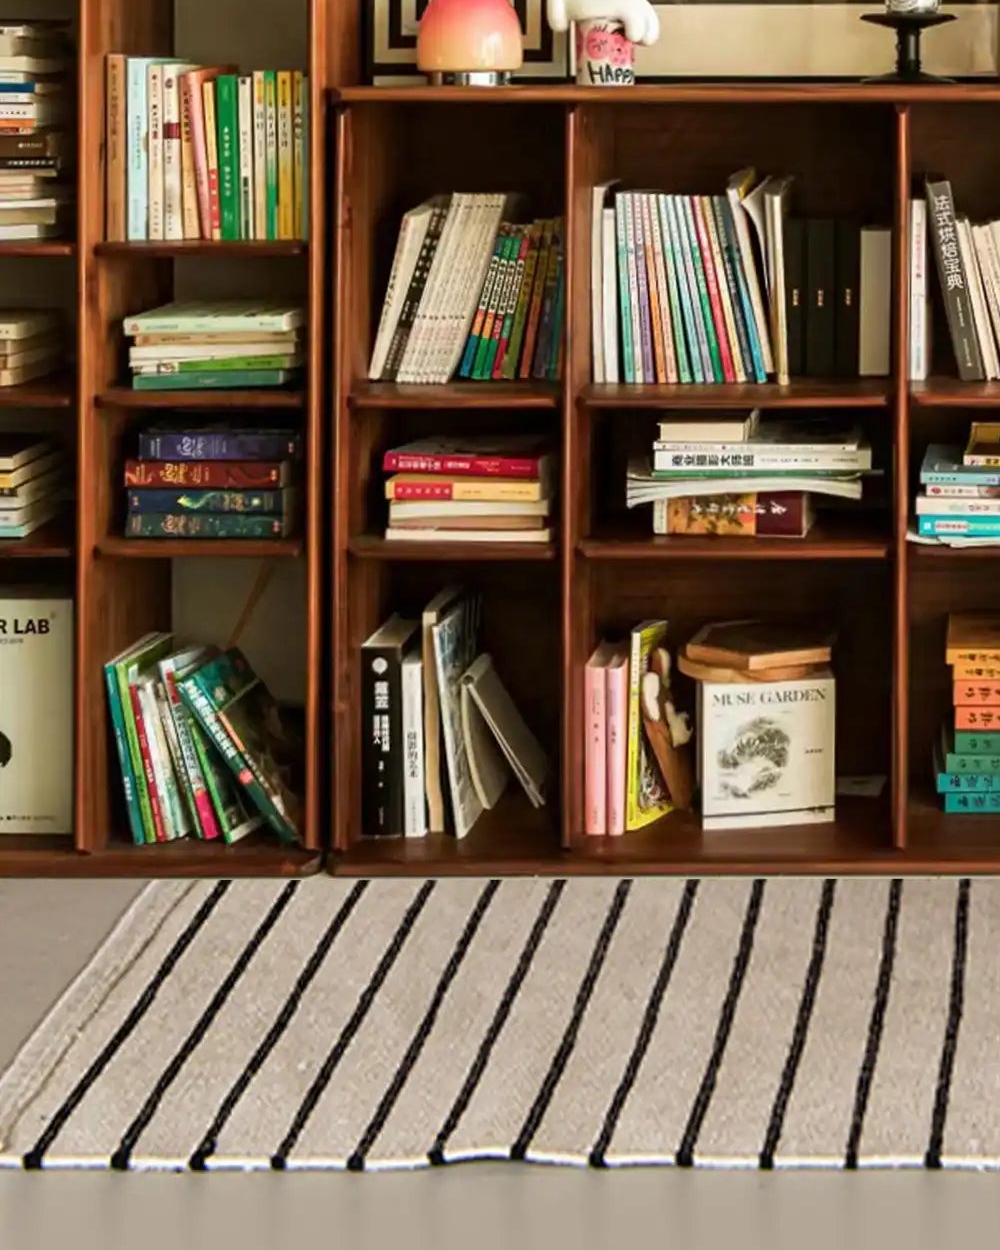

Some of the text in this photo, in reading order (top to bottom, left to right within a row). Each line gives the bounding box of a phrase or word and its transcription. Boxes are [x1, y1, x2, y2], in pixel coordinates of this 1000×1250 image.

[14, 619, 50, 634] LAB
[712, 688, 827, 707] MUSE GARDEN
